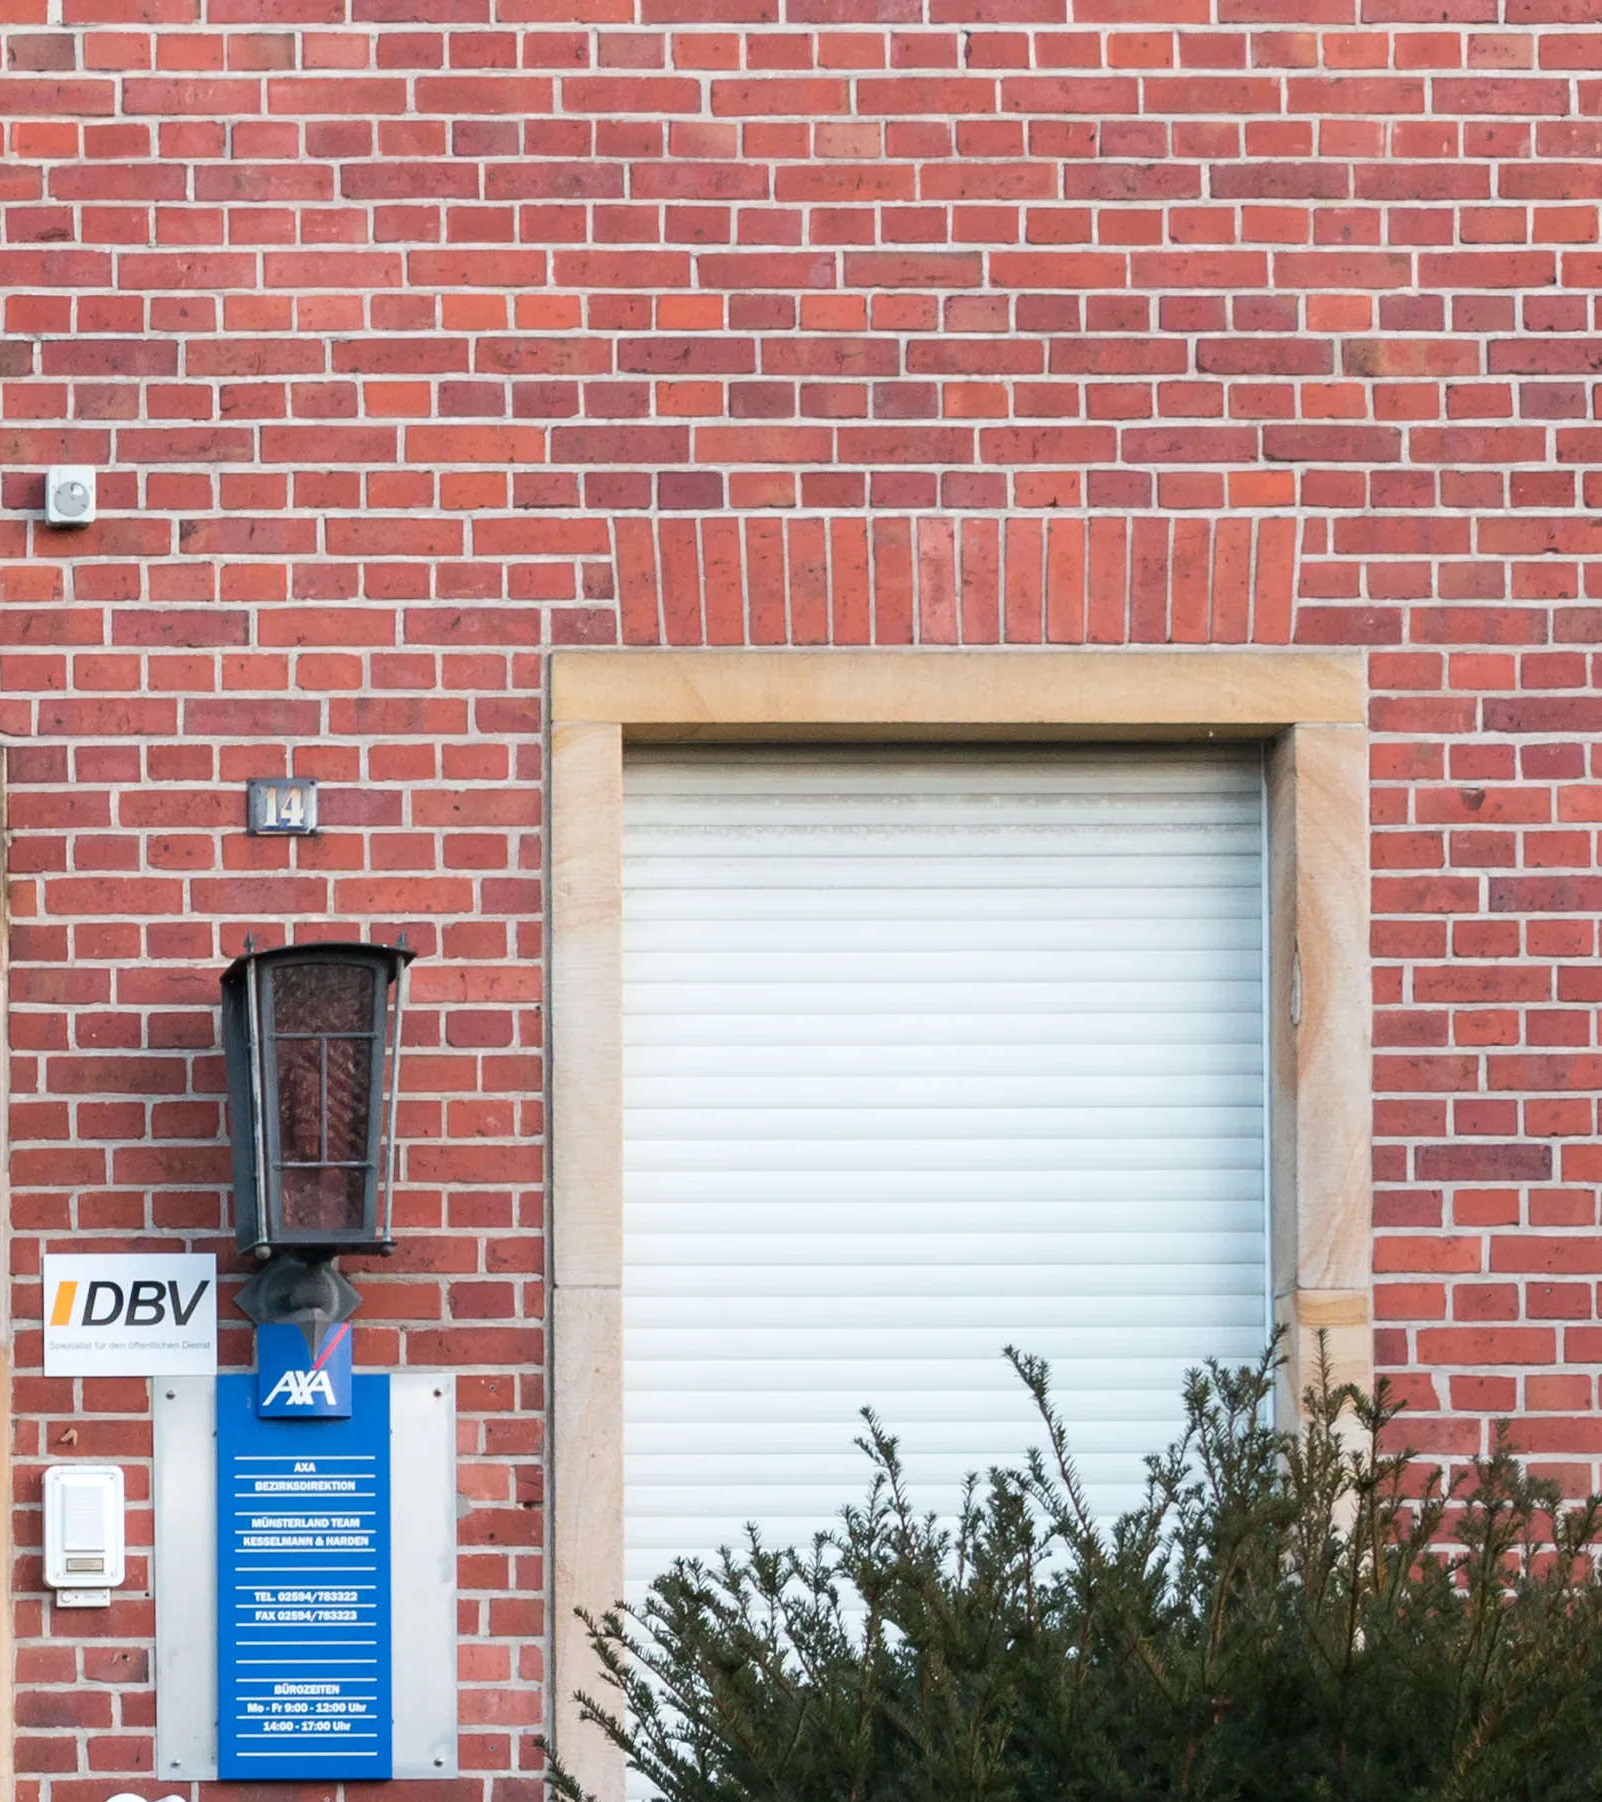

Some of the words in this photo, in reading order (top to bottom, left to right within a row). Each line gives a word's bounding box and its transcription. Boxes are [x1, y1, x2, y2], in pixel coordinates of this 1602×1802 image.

[263, 787, 305, 827] 14
[81, 1280, 210, 1326] DBV
[49, 1341, 92, 1351] Spezialist
[94, 1341, 106, 1349] für
[108, 1341, 126, 1349] den
[128, 1341, 180, 1349] öffentlichen
[182, 1341, 211, 1349] Dienst
[262, 1370, 336, 1406] AXA
[293, 1462, 316, 1473] AXA
[254, 1480, 356, 1491] BEZIRKSDIREKTION
[251, 1516, 330, 1528] MÜNSTERLAND
[330, 1517, 360, 1528] TEAM
[243, 1536, 313, 1546] KESSELMANN
[314, 1536, 324, 1546] &
[325, 1536, 369, 1546] HARDEN
[254, 1592, 276, 1602] TEL.
[277, 1591, 357, 1603] 02594/783322
[255, 1611, 276, 1621] FAX
[277, 1610, 357, 1622] 02594/783323
[273, 1682, 340, 1694] BÜROZEITEN
[247, 1703, 264, 1713] Mo
[271, 1703, 283, 1712] Fr
[284, 1703, 308, 1712] 9:00
[315, 1703, 346, 1712] 12:00
[348, 1702, 367, 1712] Uhr
[263, 1721, 294, 1731] 14:00
[301, 1721, 331, 1731] 17:00
[332, 1721, 351, 1731] Uhr
